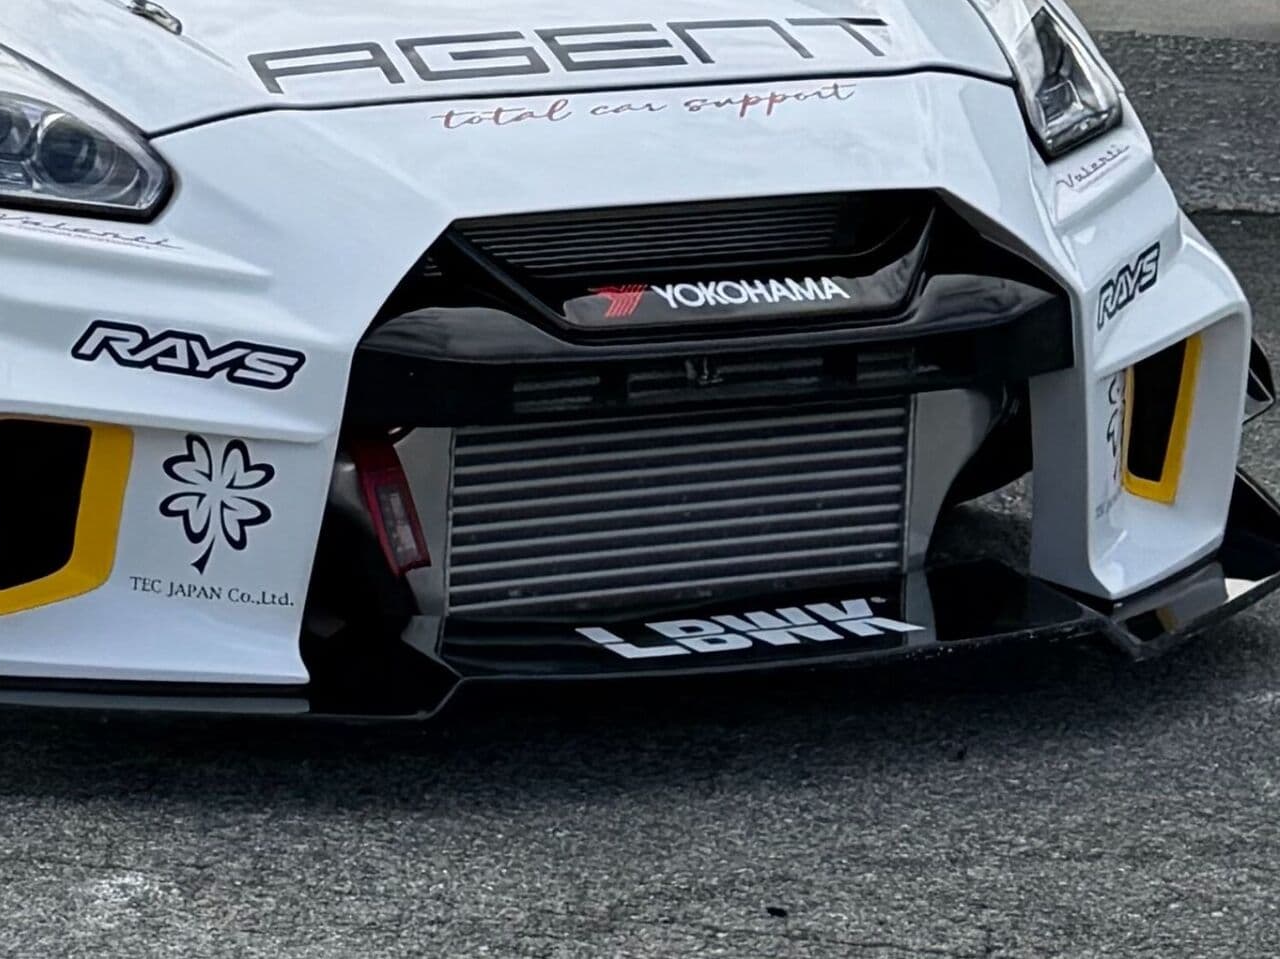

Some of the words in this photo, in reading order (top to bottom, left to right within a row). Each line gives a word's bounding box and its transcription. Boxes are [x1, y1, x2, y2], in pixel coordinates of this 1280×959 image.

[248, 17, 888, 94] AGENT
[431, 99, 572, 129] total
[589, 101, 667, 117] car
[684, 83, 857, 118] support
[651, 277, 851, 308] YOKOHAMA
[1097, 241, 1161, 331] RAYS
[71, 319, 306, 390] RAYS
[129, 576, 162, 594] TEC
[167, 581, 222, 600] JAPAN
[575, 598, 926, 659] LBWK
